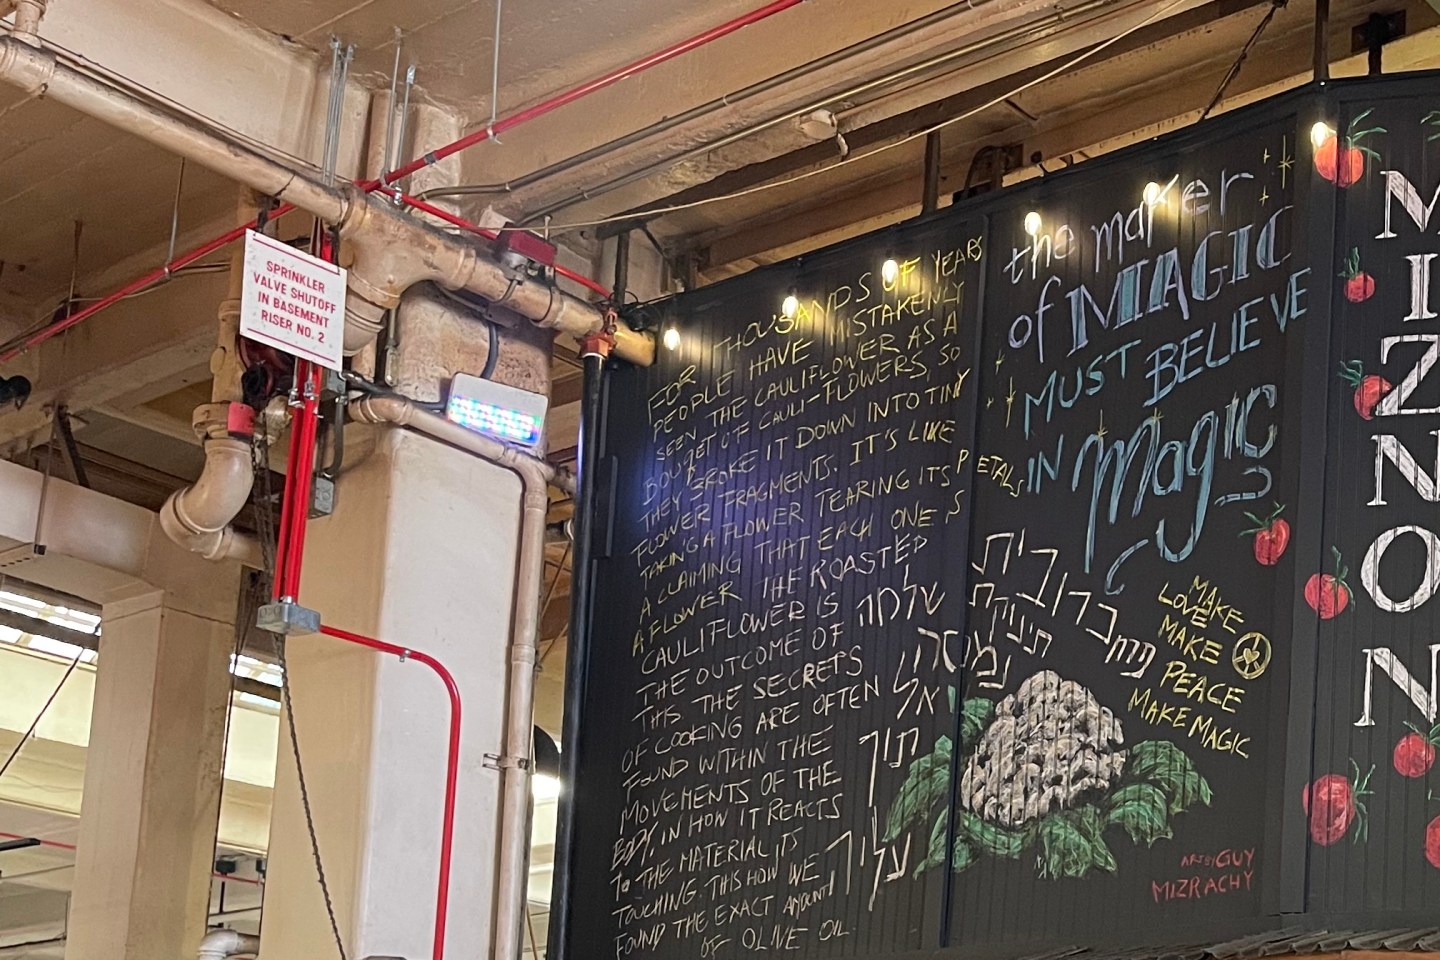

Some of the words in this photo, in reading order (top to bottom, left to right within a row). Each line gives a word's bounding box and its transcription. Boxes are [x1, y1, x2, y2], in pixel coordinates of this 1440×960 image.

[252, 272, 288, 296] VALVE
[290, 284, 336, 314] SHUTOFF
[266, 260, 326, 294] SPRINKLER
[1008, 275, 1061, 362] of
[1067, 206, 1293, 356] MAGIC
[258, 292, 270, 306] IN
[272, 296, 329, 328] BASEMENT
[261, 309, 293, 331] RISER
[296, 319, 315, 338] NO.
[318, 331, 324, 344] 2
[654, 370, 735, 443] PEOPLE
[749, 341, 814, 381] HAVE
[830, 282, 965, 346] MISTAKENLY
[939, 346, 961, 366] SO
[1025, 340, 1142, 438] MUST
[1143, 268, 1311, 407] BELIEVE
[657, 431, 697, 461] SEEN
[706, 396, 748, 428] THE
[755, 333, 902, 408] CAULIFLOWER
[908, 327, 936, 349] AS
[638, 490, 682, 532] THEY
[767, 436, 790, 461] IT
[798, 412, 856, 449] DOWN
[868, 391, 920, 422] INTO
[1028, 434, 1064, 494] IN
[631, 503, 710, 567] FLOWER
[850, 429, 897, 465] IT'S
[908, 420, 956, 444] LIKE
[723, 503, 805, 545] FLOWER
[816, 472, 910, 516] TEARING
[659, 553, 742, 604] CLAIMING
[755, 536, 809, 564] THAT
[817, 515, 873, 551] EACH
[891, 501, 938, 530] ONE
[650, 580, 742, 642] FLOWER
[762, 568, 801, 599] THE
[810, 535, 928, 589] ROASTED
[1158, 581, 1208, 628] LOVE
[1189, 575, 1245, 634] MAKE
[641, 601, 806, 675] CAULIFLOWER
[816, 591, 838, 618] IS
[1158, 615, 1223, 665] MAKE
[637, 668, 691, 705] THE
[696, 628, 801, 684] OUTCOME
[812, 622, 844, 649] OF
[692, 689, 742, 724] THE
[754, 646, 863, 701] SECRETS
[1160, 661, 1245, 713] PEACE
[654, 715, 742, 754] COOKING
[756, 702, 799, 734] ARE
[812, 676, 879, 716] OFTEN
[1127, 688, 1192, 728] MAKE
[1188, 715, 1250, 759] MAGIC
[620, 779, 753, 835] MOVEMENTS
[761, 771, 787, 796] OF
[792, 760, 842, 790] THE
[623, 759, 689, 802] FOUND
[699, 744, 767, 776] WITHIN
[768, 793, 844, 824] REACTS
[679, 839, 771, 875] MATERIAL
[1216, 848, 1255, 868] GUY
[715, 896, 773, 924] EXACT
[1152, 871, 1253, 903] MIZRACHY
[742, 927, 808, 950] OLIVE
[818, 920, 849, 940] OIL
